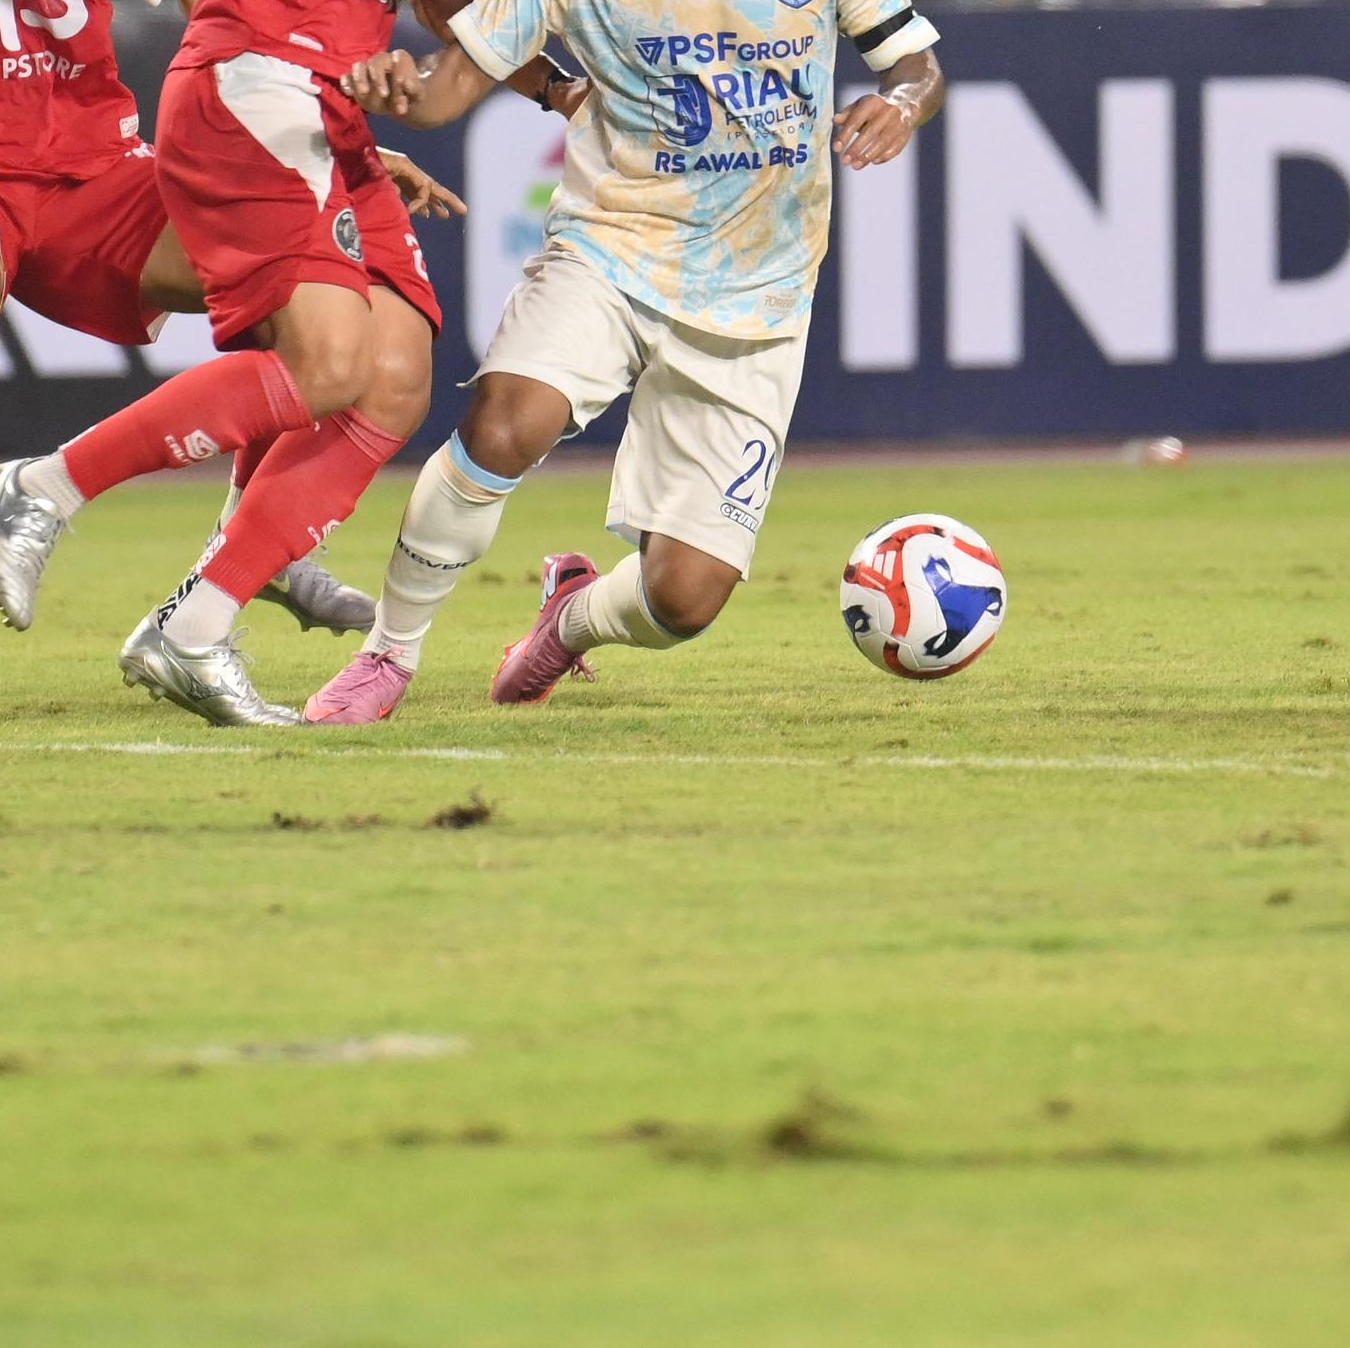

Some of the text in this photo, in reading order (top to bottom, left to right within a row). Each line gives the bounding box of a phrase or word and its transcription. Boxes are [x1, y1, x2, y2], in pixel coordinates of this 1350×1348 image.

[2, 50, 87, 80] PSTORE
[712, 63, 814, 112] RIAU
[654, 152, 687, 174] RS
[694, 151, 763, 173] AWAL
